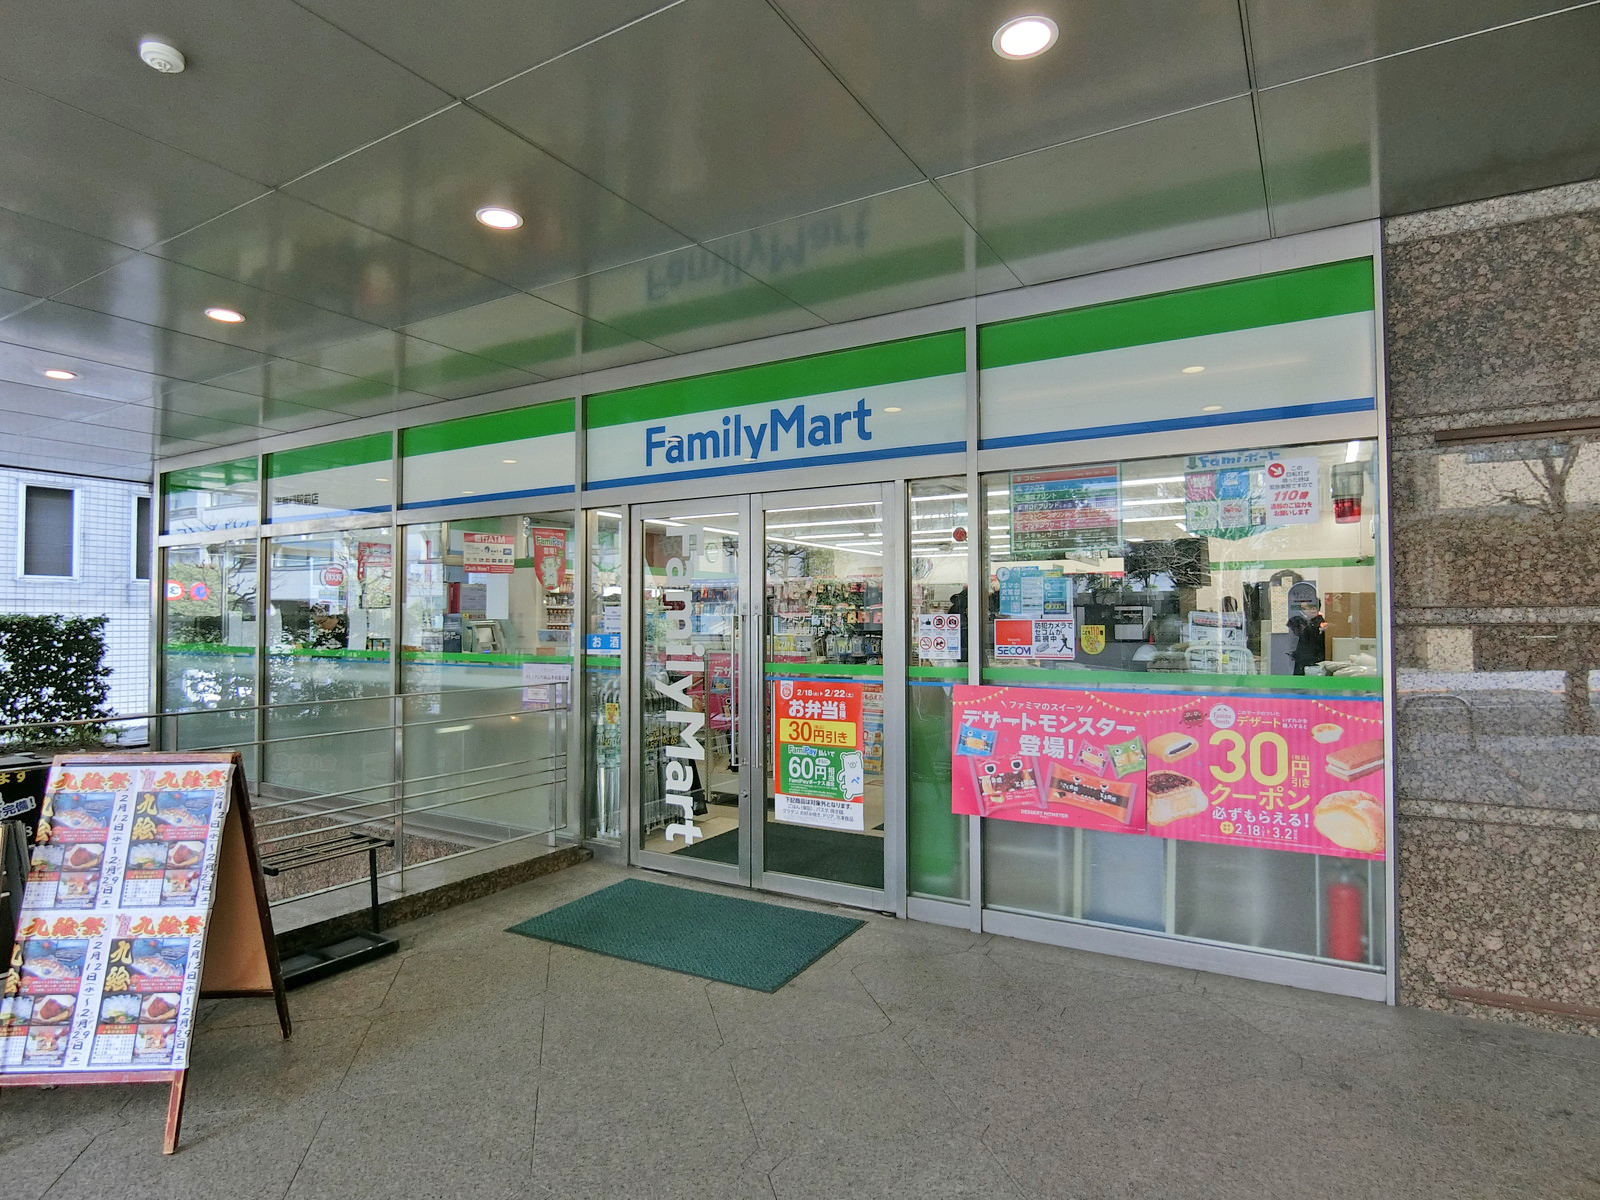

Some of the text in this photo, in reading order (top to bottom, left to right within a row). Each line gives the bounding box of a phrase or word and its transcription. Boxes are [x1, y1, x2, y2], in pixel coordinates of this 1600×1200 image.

[646, 398, 872, 467] FamilyMart
[592, 636, 619, 648] お酒
[997, 646, 1031, 655] SECOM
[788, 699, 838, 719] お弁当
[1009, 700, 1083, 712] ファミマのスイーツ
[962, 709, 1136, 737] デザートモンスター
[1237, 715, 1281, 728] デザート
[788, 744, 817, 757] FamiPay
[1018, 734, 1074, 759] 登場!
[1208, 729, 1288, 787] 30
[1209, 783, 1311, 811] クーポン
[1212, 806, 1309, 828] 必ずもらえる!
[1235, 823, 1260, 836] 2.18
